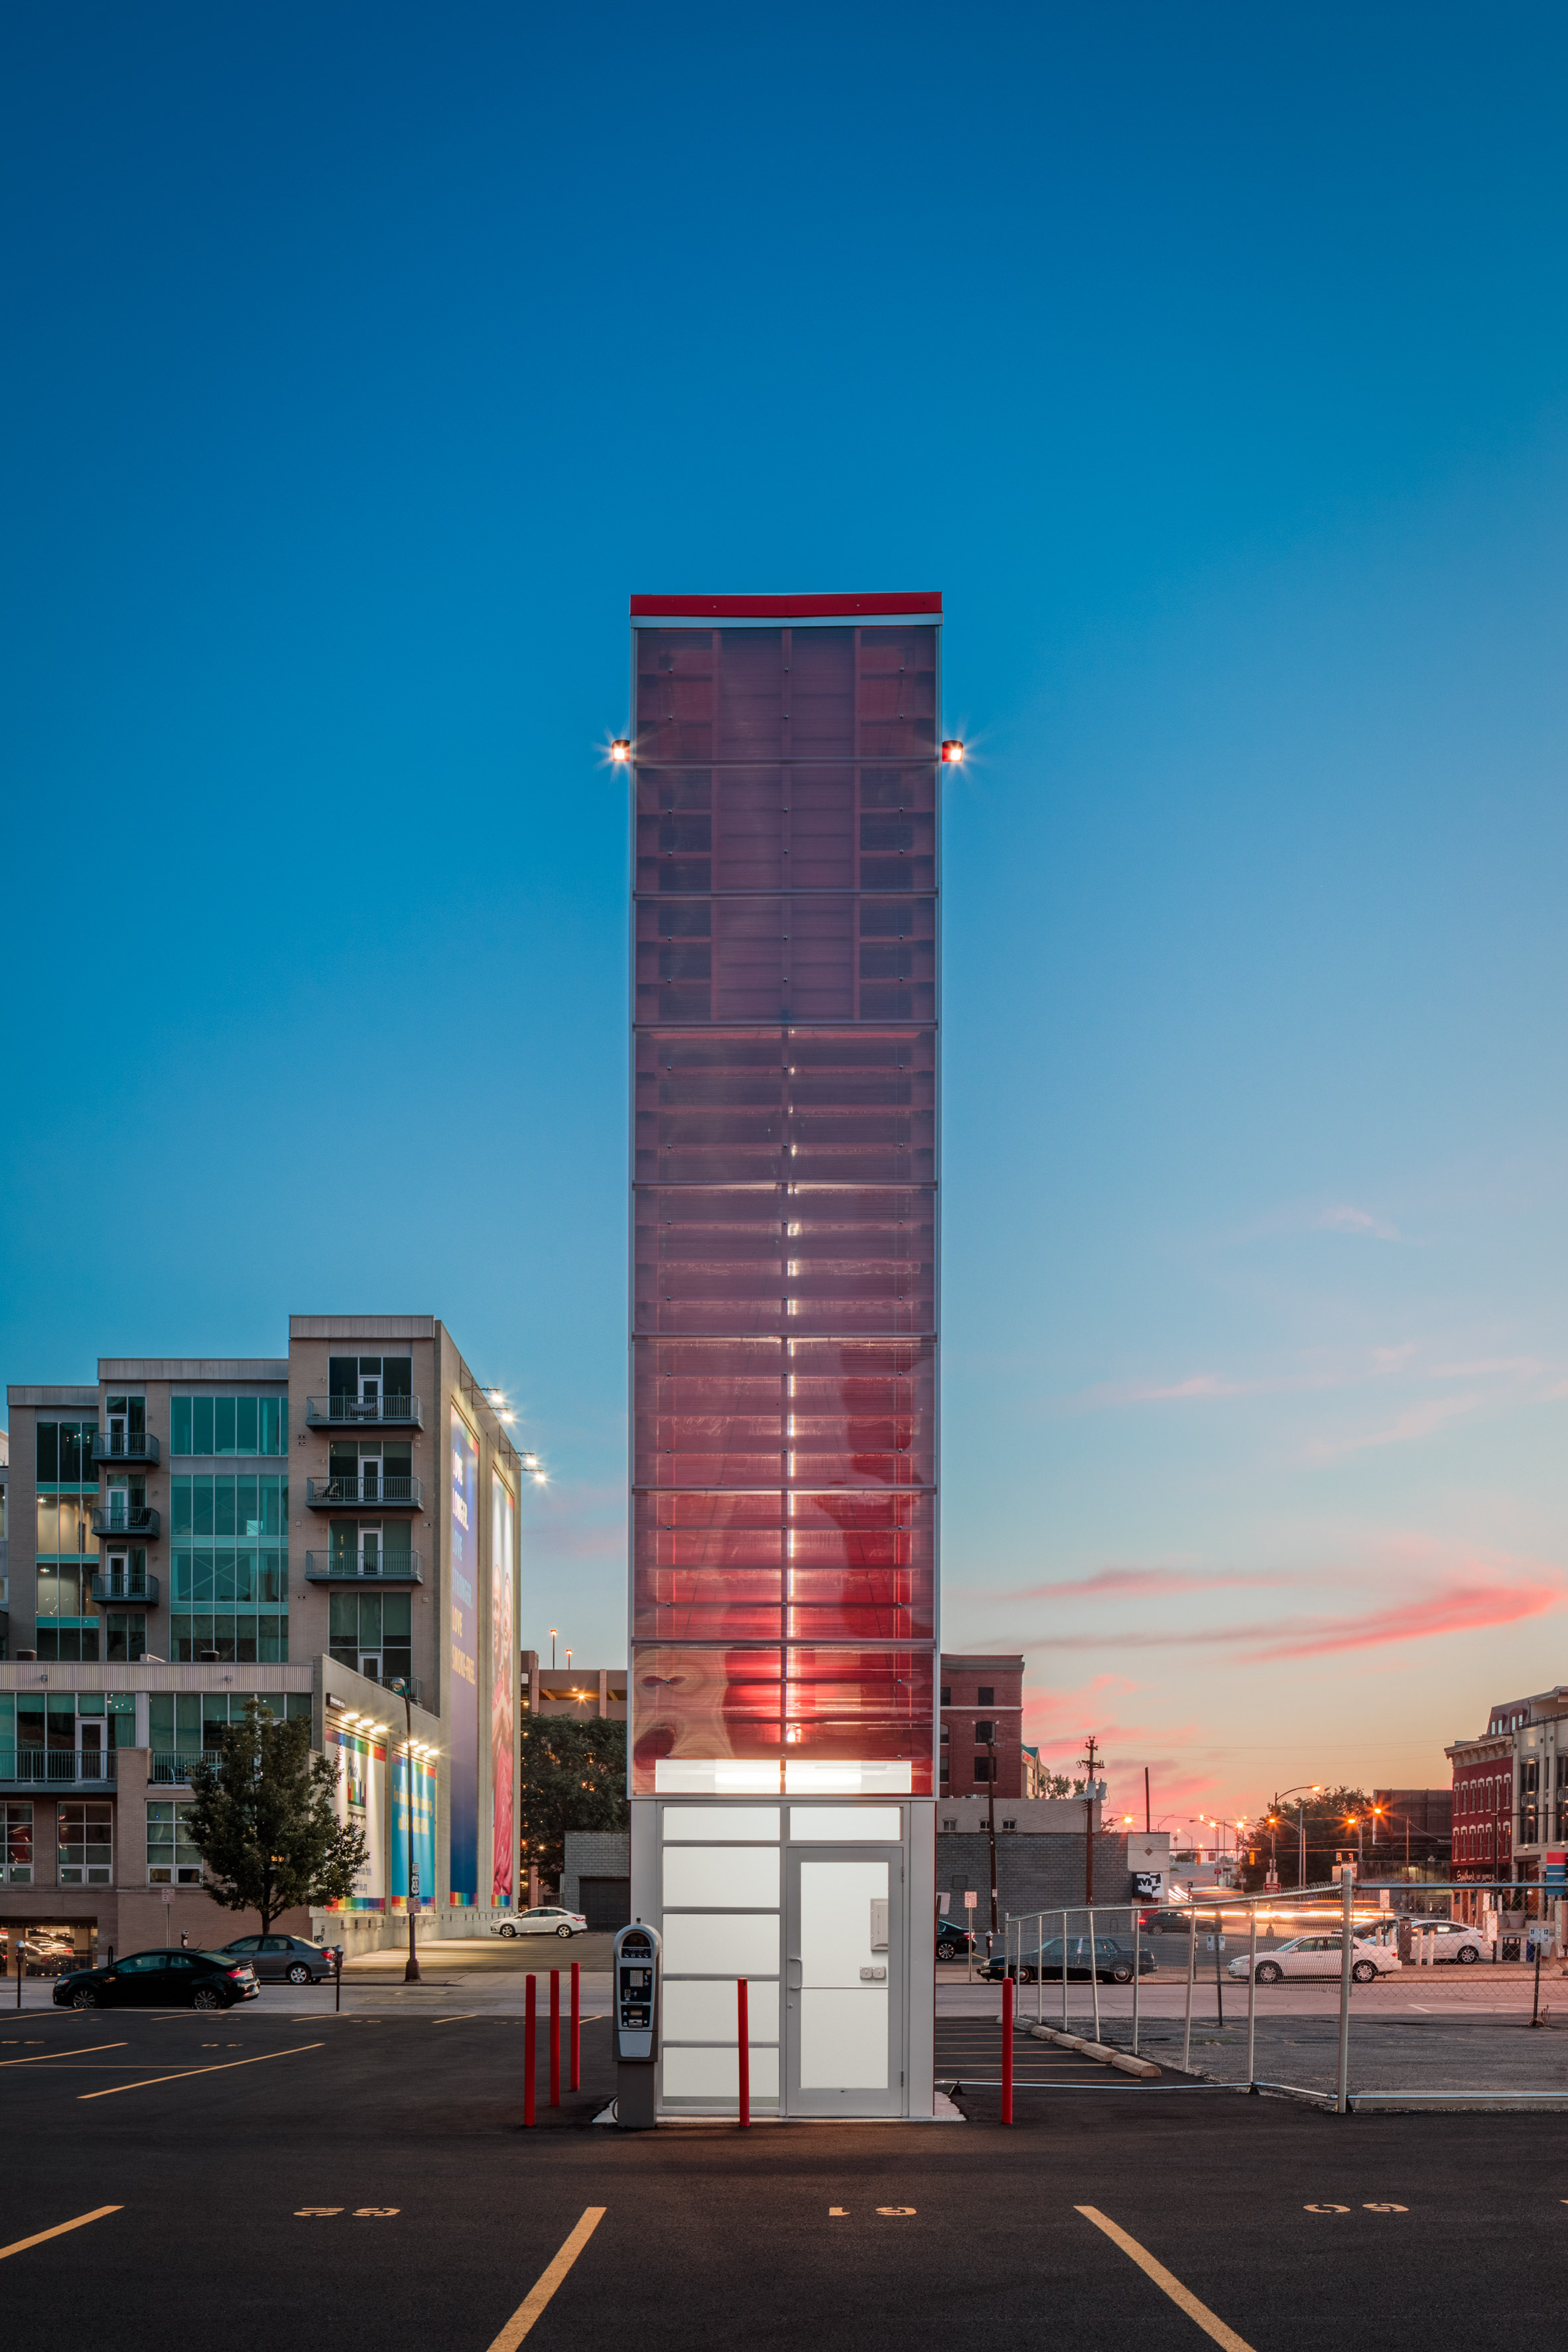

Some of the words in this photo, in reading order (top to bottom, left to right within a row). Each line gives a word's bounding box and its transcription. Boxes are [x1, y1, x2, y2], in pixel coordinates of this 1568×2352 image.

[452, 1448, 463, 1486] LOVE
[452, 1487, 469, 1532] LONGER.
[452, 1530, 463, 1561] LOVE
[452, 1566, 473, 1610] STRONGER.
[452, 1604, 462, 1638] LOVE
[413, 1879, 419, 1890] 33
